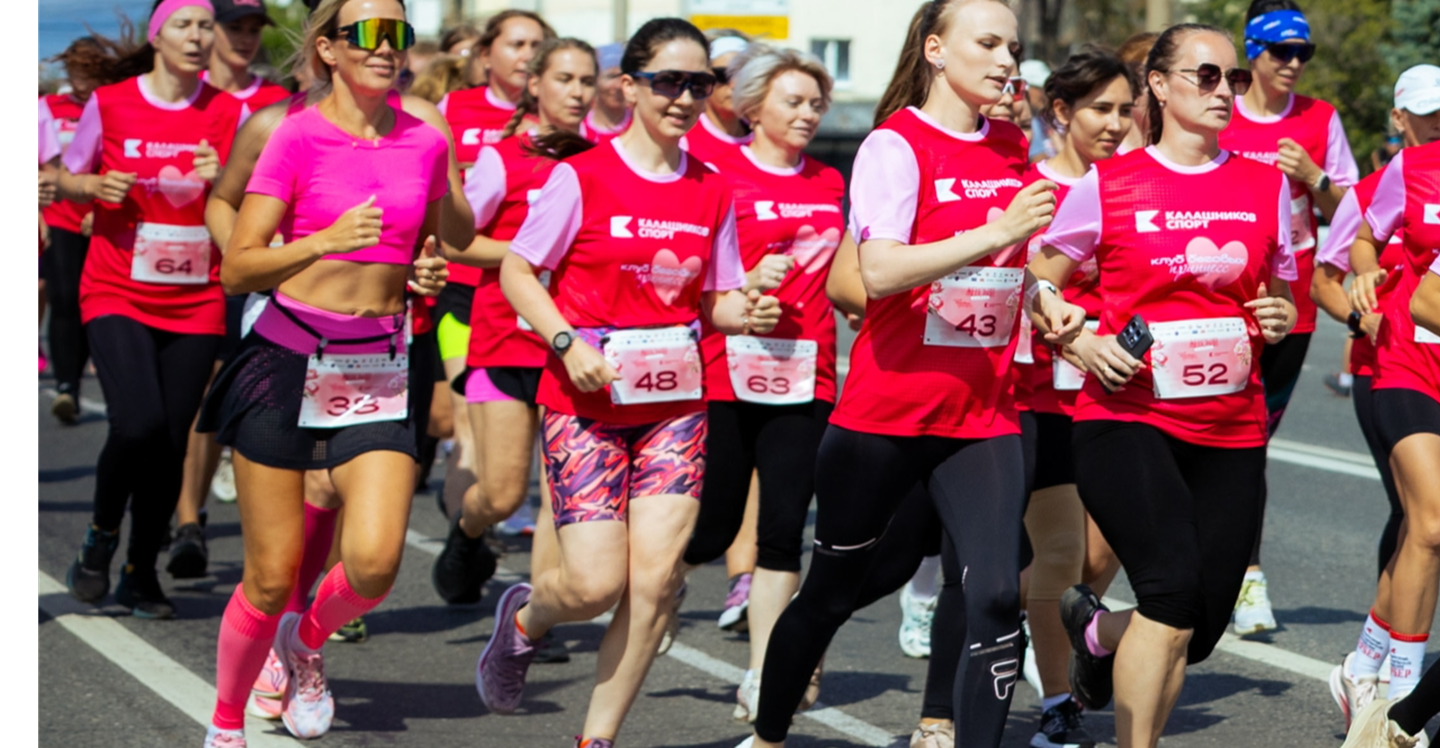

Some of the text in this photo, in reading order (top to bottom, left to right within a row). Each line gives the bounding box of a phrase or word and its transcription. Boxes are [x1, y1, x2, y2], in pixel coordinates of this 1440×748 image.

[1165, 211, 1257, 222] КАЛАШНИКОВ
[1166, 220, 1209, 230] СПОРТ
[155, 258, 192, 275] 64
[955, 314, 997, 337] 43
[634, 370, 678, 392] 48
[1182, 363, 1229, 386] 52
[747, 375, 790, 395] 63
